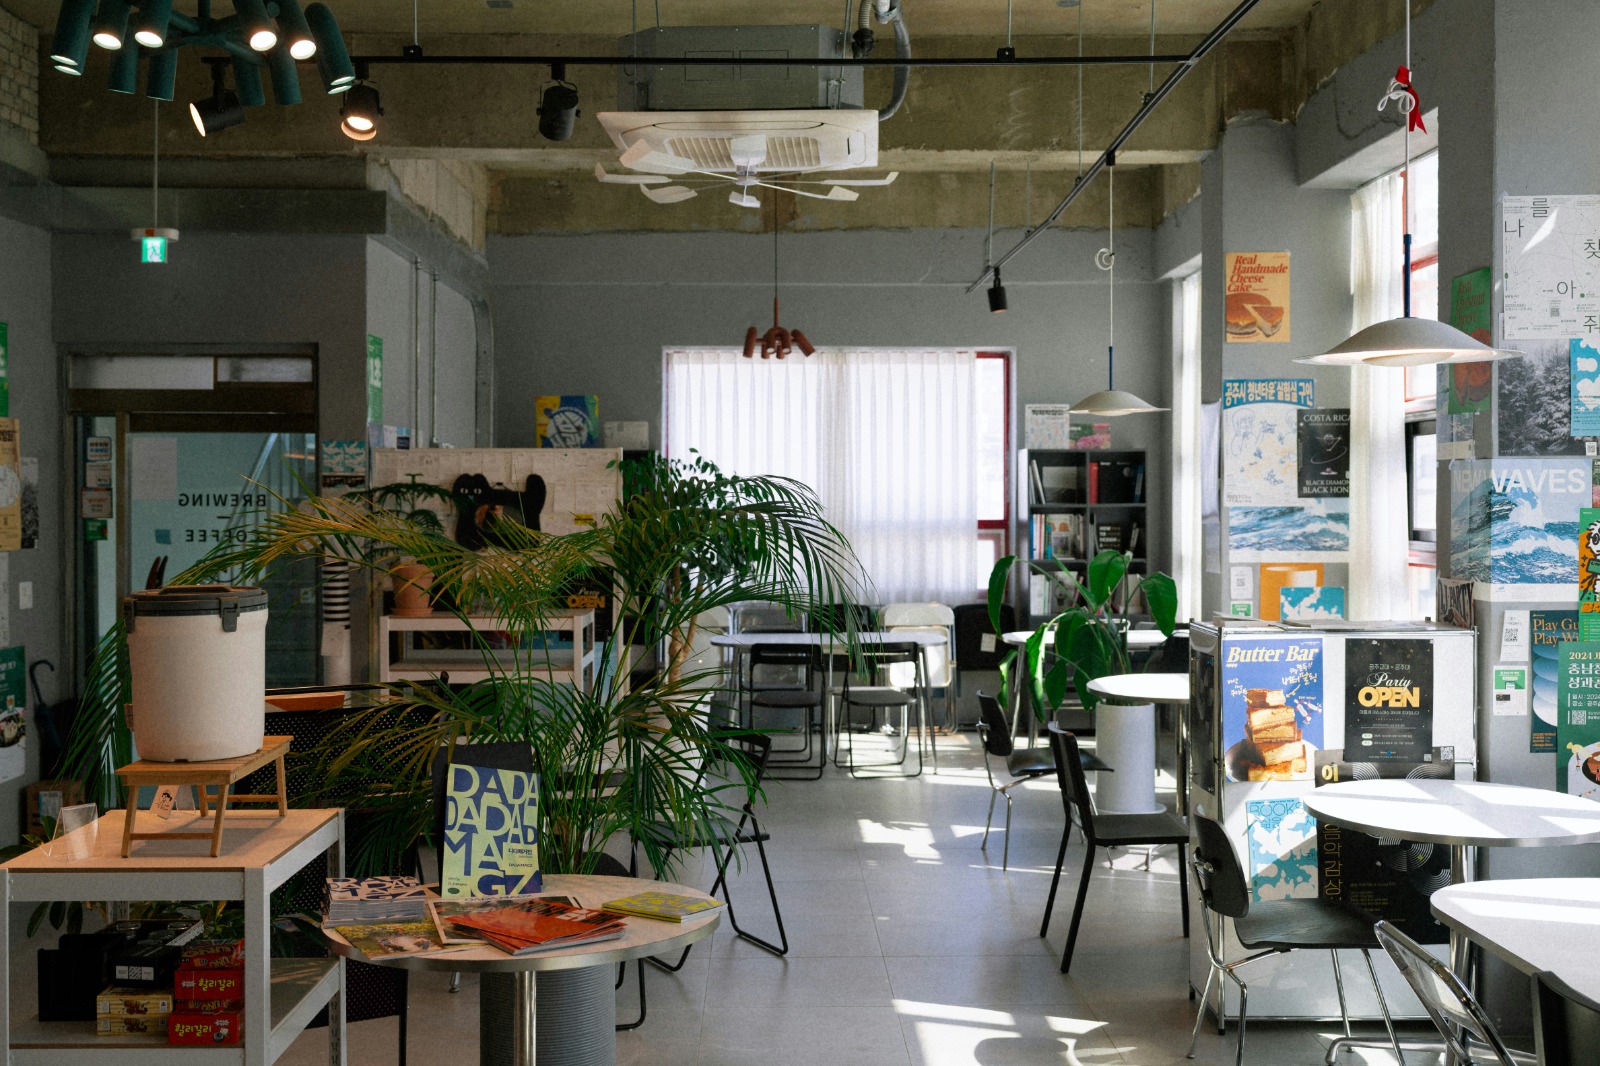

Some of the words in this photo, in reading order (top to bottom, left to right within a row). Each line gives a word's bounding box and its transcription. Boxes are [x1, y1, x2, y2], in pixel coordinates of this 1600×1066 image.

[1504, 218, 1525, 238] 나
[1235, 254, 1258, 265] Real
[1232, 263, 1288, 274] Handmade
[1230, 273, 1265, 283] Cheese
[1227, 282, 1252, 293] Cake
[1225, 381, 1247, 407] 공주시
[1303, 414, 1332, 423] COSTA
[1302, 486, 1329, 494] BLACK
[567, 595, 605, 608] OPEN
[1533, 618, 1558, 634] Play
[1533, 632, 1559, 647] Play
[1226, 646, 1285, 663] Butter
[1285, 645, 1319, 662] Bar
[1569, 651, 1592, 660] 2024
[1367, 671, 1413, 692] Party
[1358, 686, 1420, 708] OPEN
[447, 764, 540, 807] DADA
[1323, 823, 1343, 900] 음악감상
[198, 978, 235, 992] 할리갈리
[175, 1022, 212, 1037] 할리갈리
